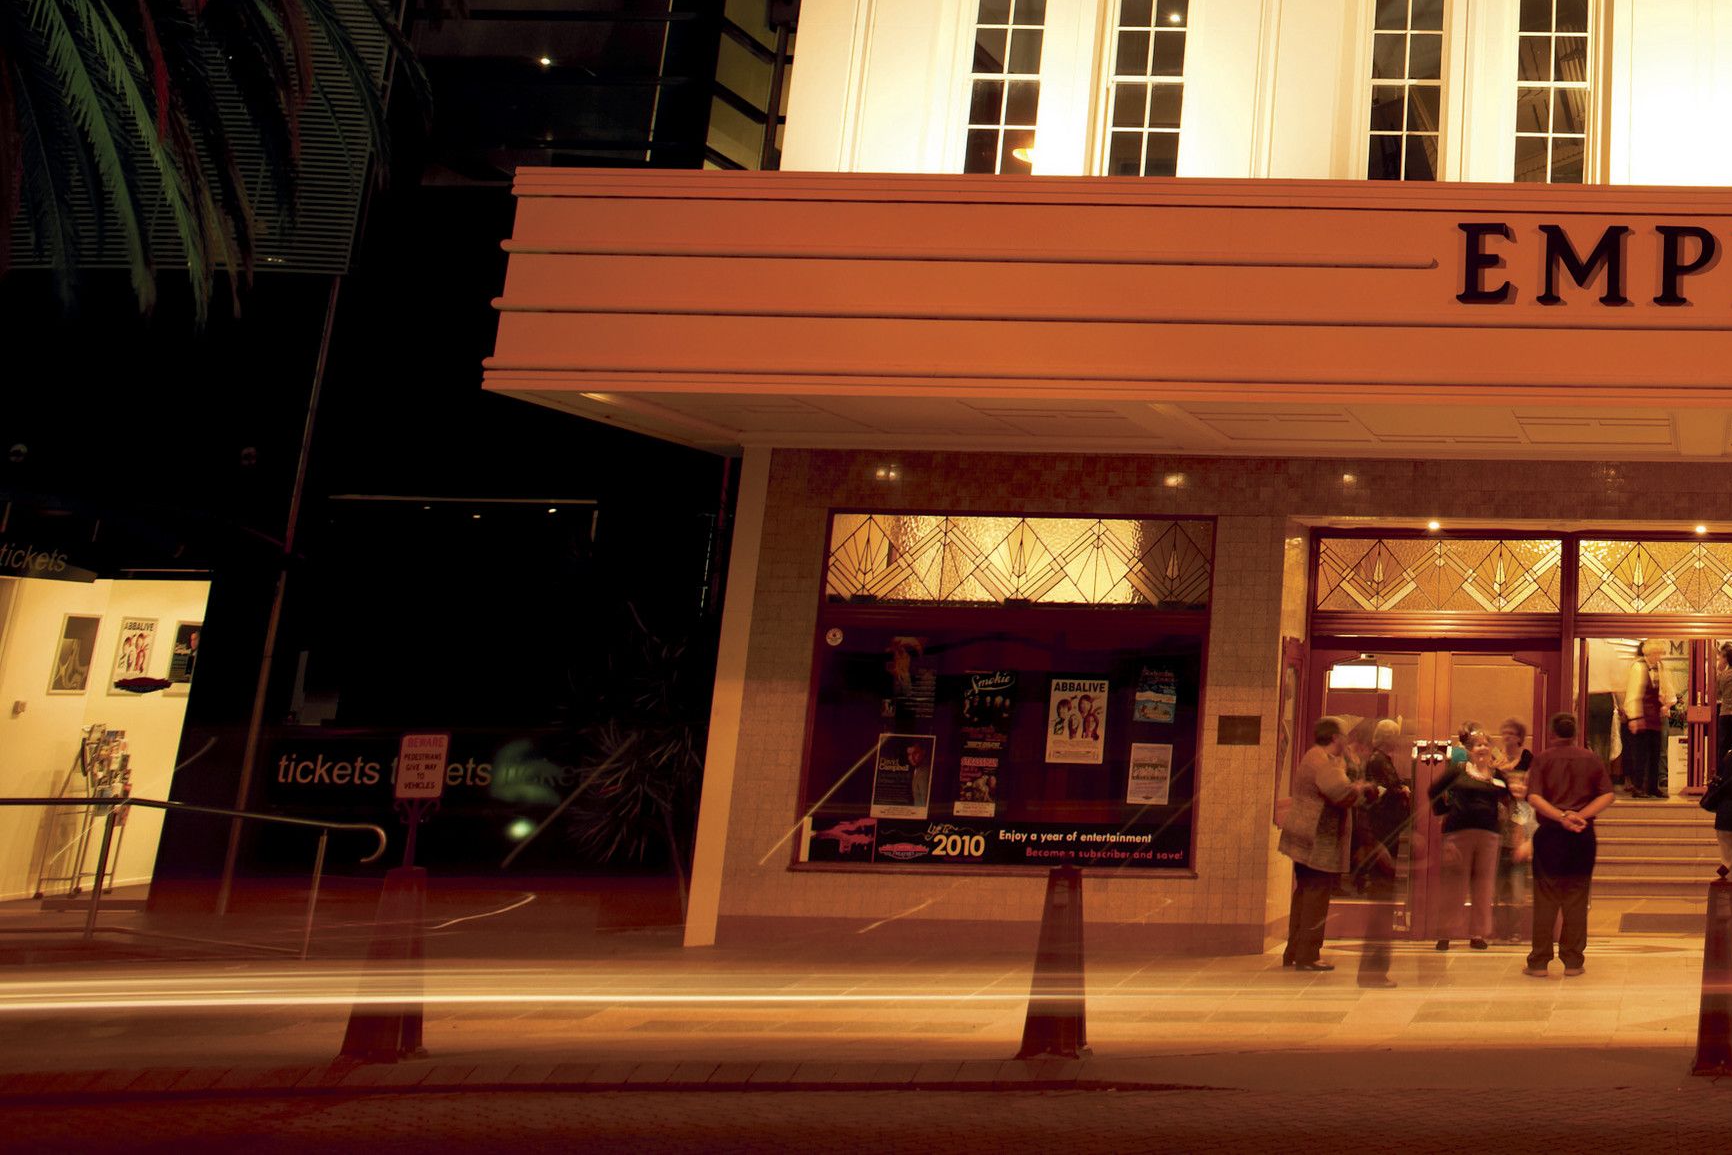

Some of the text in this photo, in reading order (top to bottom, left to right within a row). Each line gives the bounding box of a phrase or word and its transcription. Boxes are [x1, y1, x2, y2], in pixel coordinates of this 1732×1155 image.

[124, 621, 154, 632] ABBALIVE
[966, 671, 1014, 696] Smokie
[1054, 682, 1106, 693] ABBALIVE
[407, 738, 444, 748] BEWARE
[277, 754, 381, 784] tickets
[999, 830, 1027, 843] Enjoy
[1040, 833, 1063, 843] year
[1066, 831, 1077, 842] of
[1080, 832, 1152, 843] entertainment
[932, 835, 986, 856] 2010
[1026, 847, 1065, 857] Become
[1078, 848, 1130, 858] subscriber
[1133, 849, 1153, 859] and
[1156, 849, 1183, 860] save!
